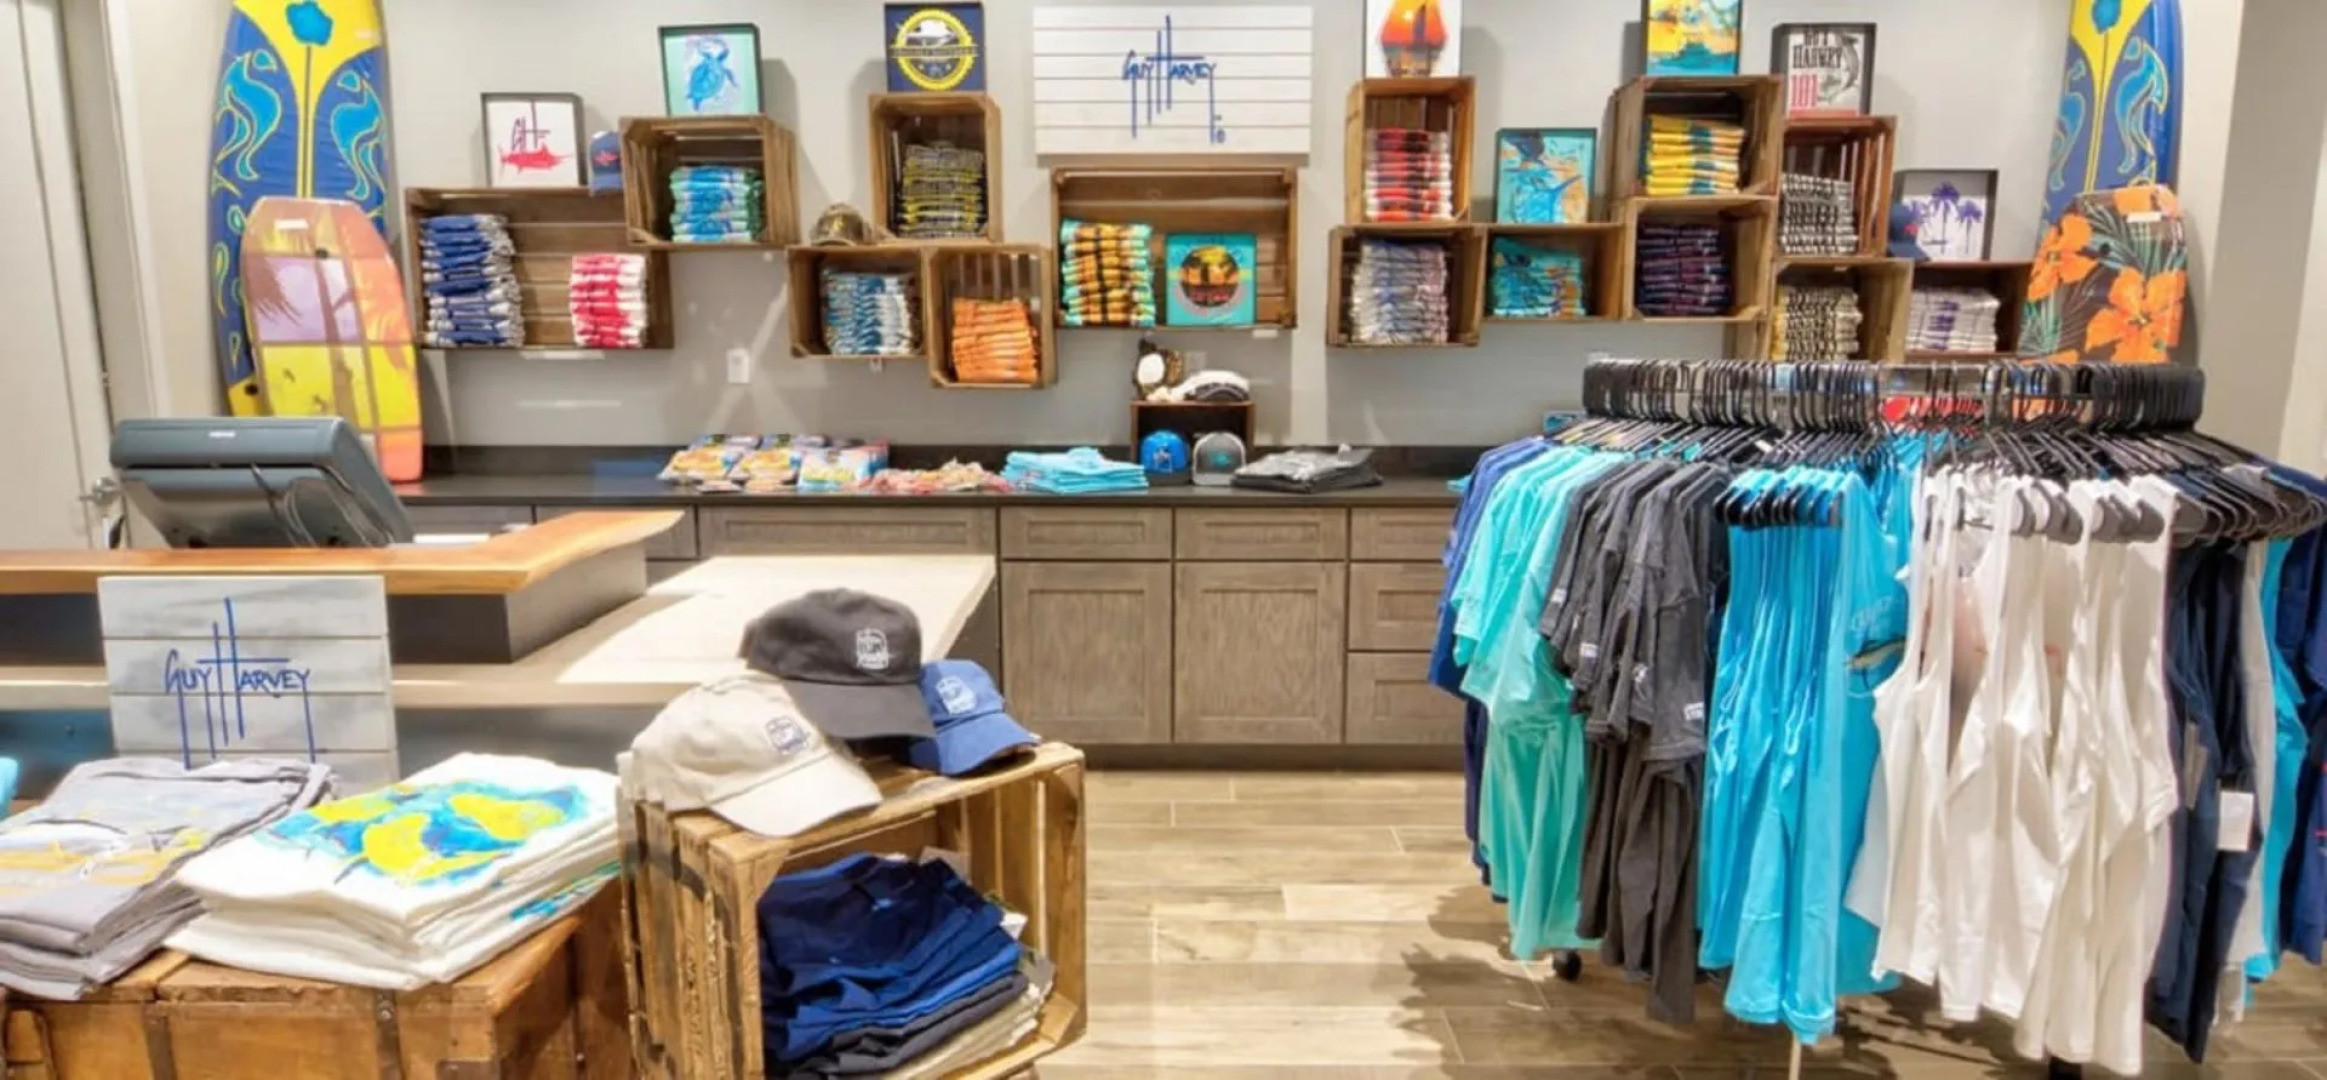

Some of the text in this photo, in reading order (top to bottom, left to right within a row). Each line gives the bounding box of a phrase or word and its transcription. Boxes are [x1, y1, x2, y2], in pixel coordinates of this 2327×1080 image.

[1145, 14, 1217, 144] HARVEY
[1791, 74, 1818, 108] 101
[196, 597, 318, 764] HARVEY
